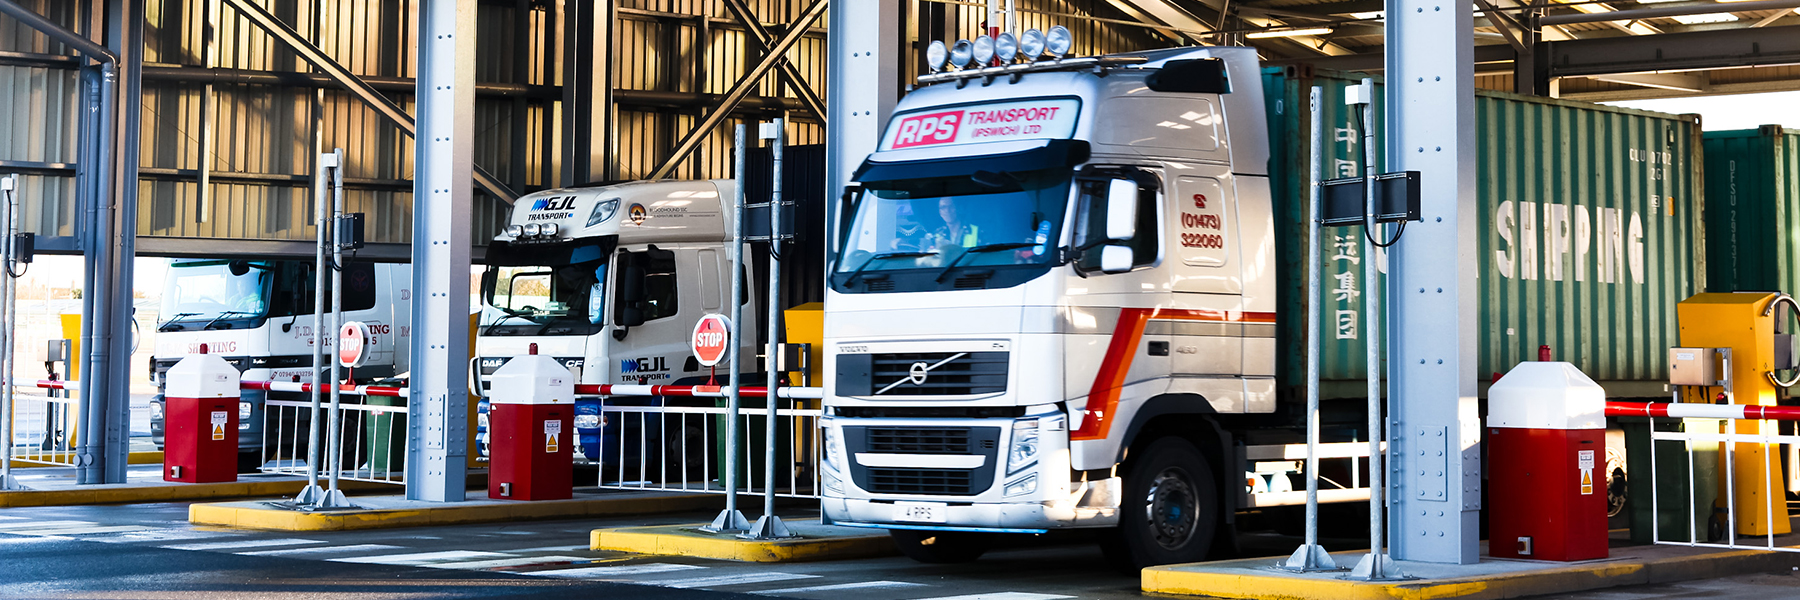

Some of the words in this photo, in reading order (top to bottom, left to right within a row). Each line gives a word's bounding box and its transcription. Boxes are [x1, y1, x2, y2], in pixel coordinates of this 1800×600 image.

[896, 115, 958, 145] RPS
[968, 106, 1060, 125] TRANSPORT
[1023, 124, 1042, 135] LTD
[544, 196, 577, 211] GJL
[528, 212, 569, 221] TRANSPORT
[1181, 211, 1221, 230] (01473)
[1331, 121, 1361, 340] 中国运集团
[1181, 233, 1223, 249] 322060
[1496, 200, 1645, 284] SHIPPING
[339, 337, 360, 352] STOP
[697, 332, 723, 348] STOP
[482, 359, 503, 368] DAF
[636, 356, 670, 372] GJL
